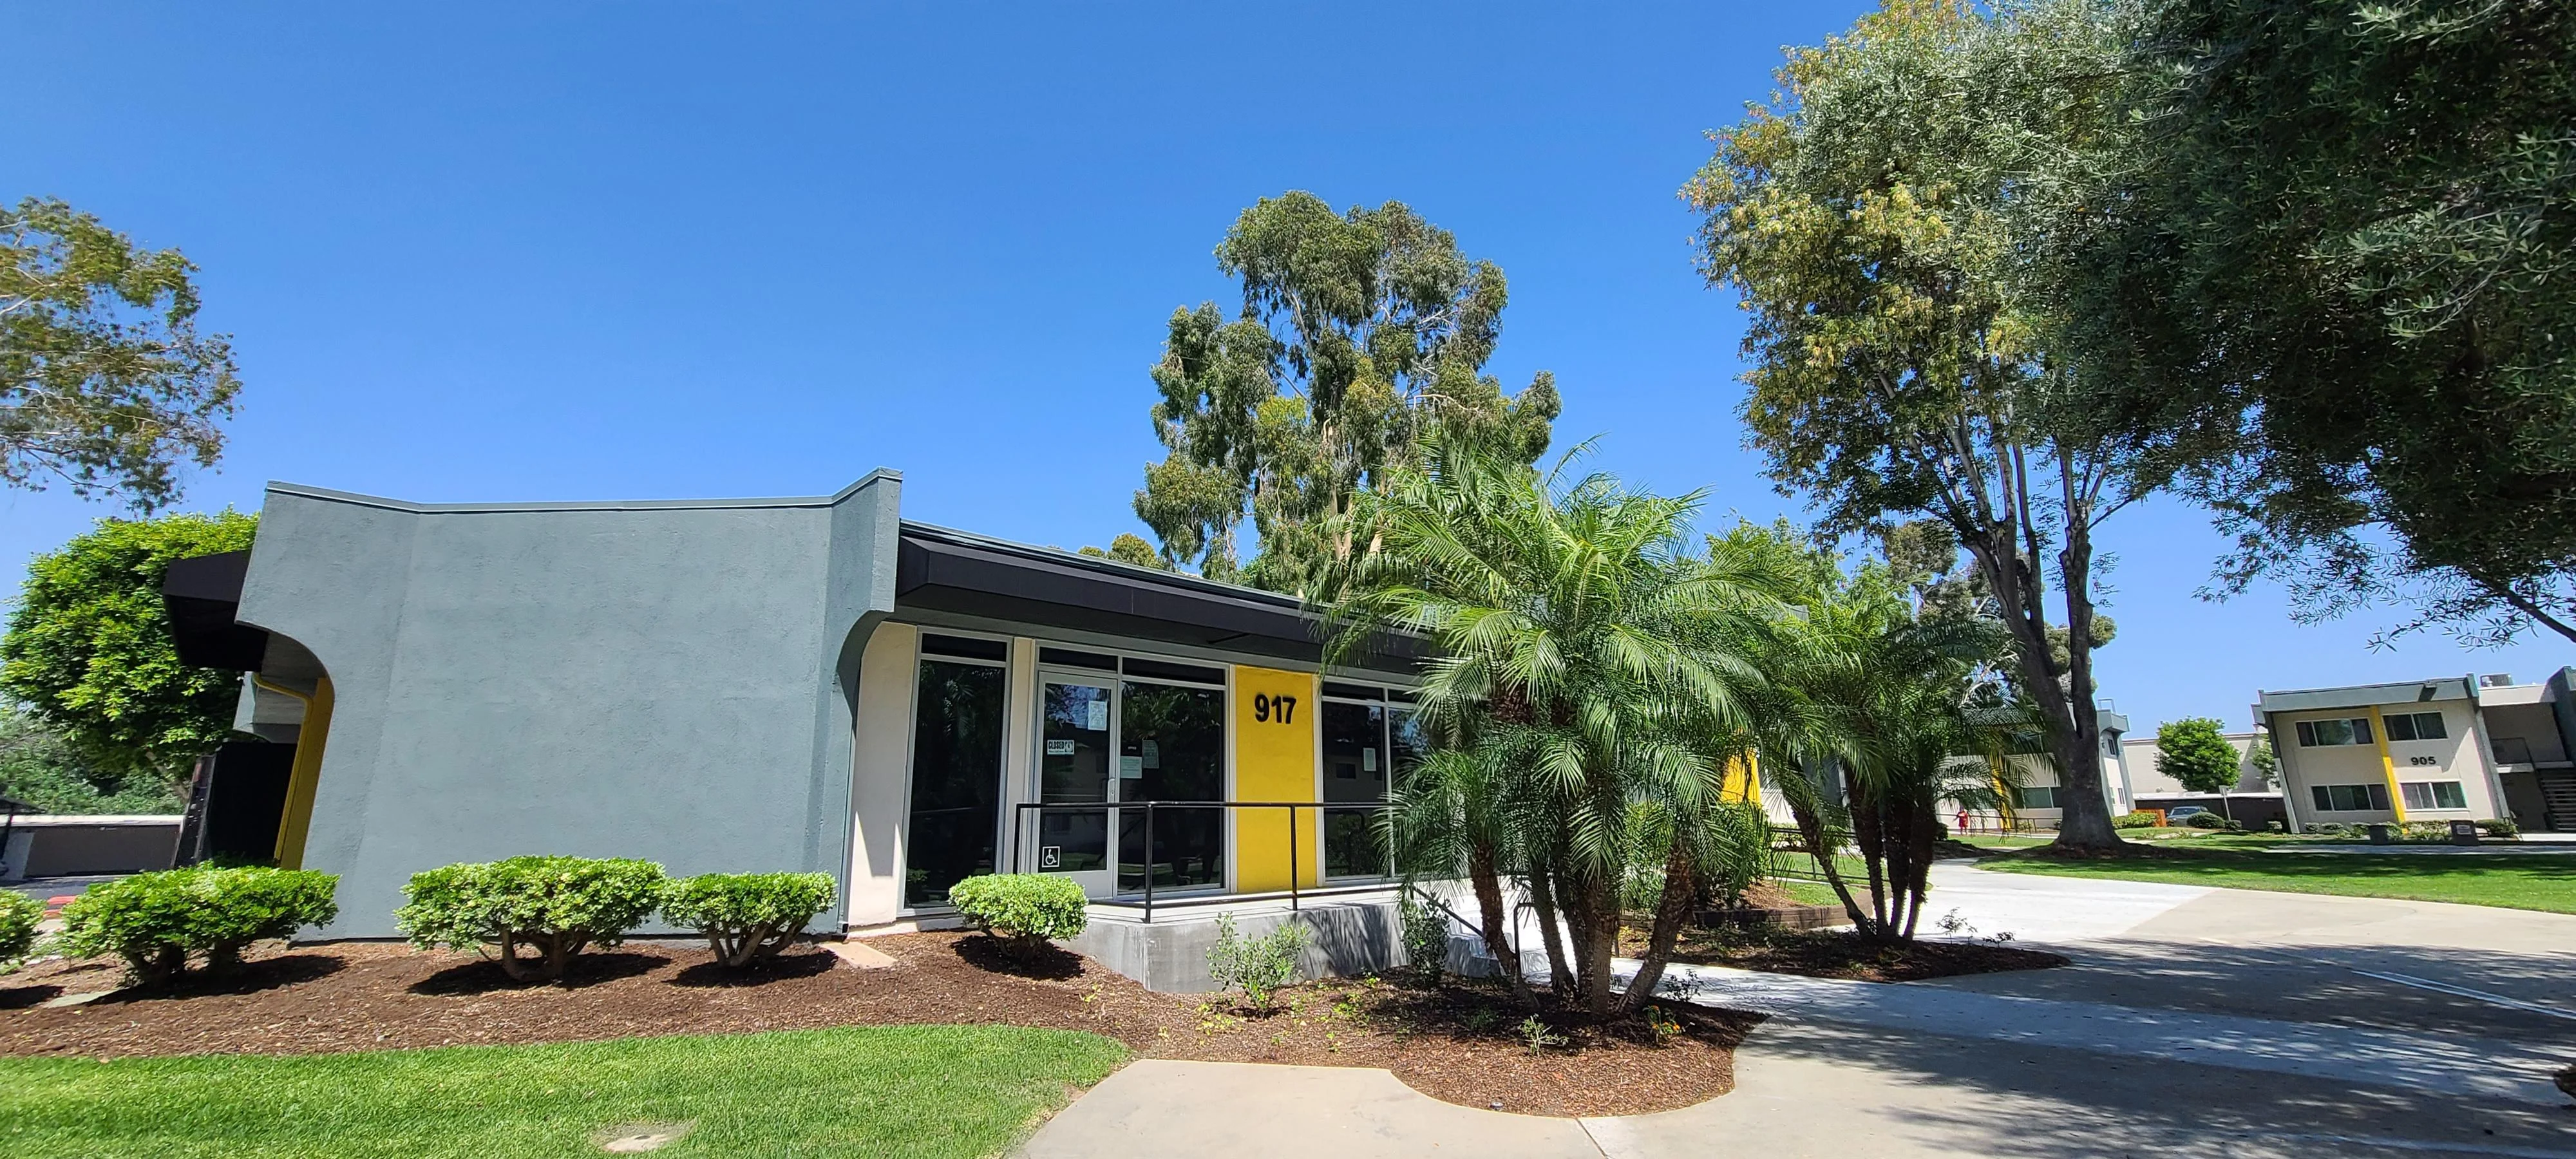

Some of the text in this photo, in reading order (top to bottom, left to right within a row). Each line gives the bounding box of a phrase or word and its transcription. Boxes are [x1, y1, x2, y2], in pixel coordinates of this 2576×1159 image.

[1255, 694, 1296, 724] 917
[1048, 741, 1065, 749] CLOSED
[2410, 756, 2436, 765] 905
